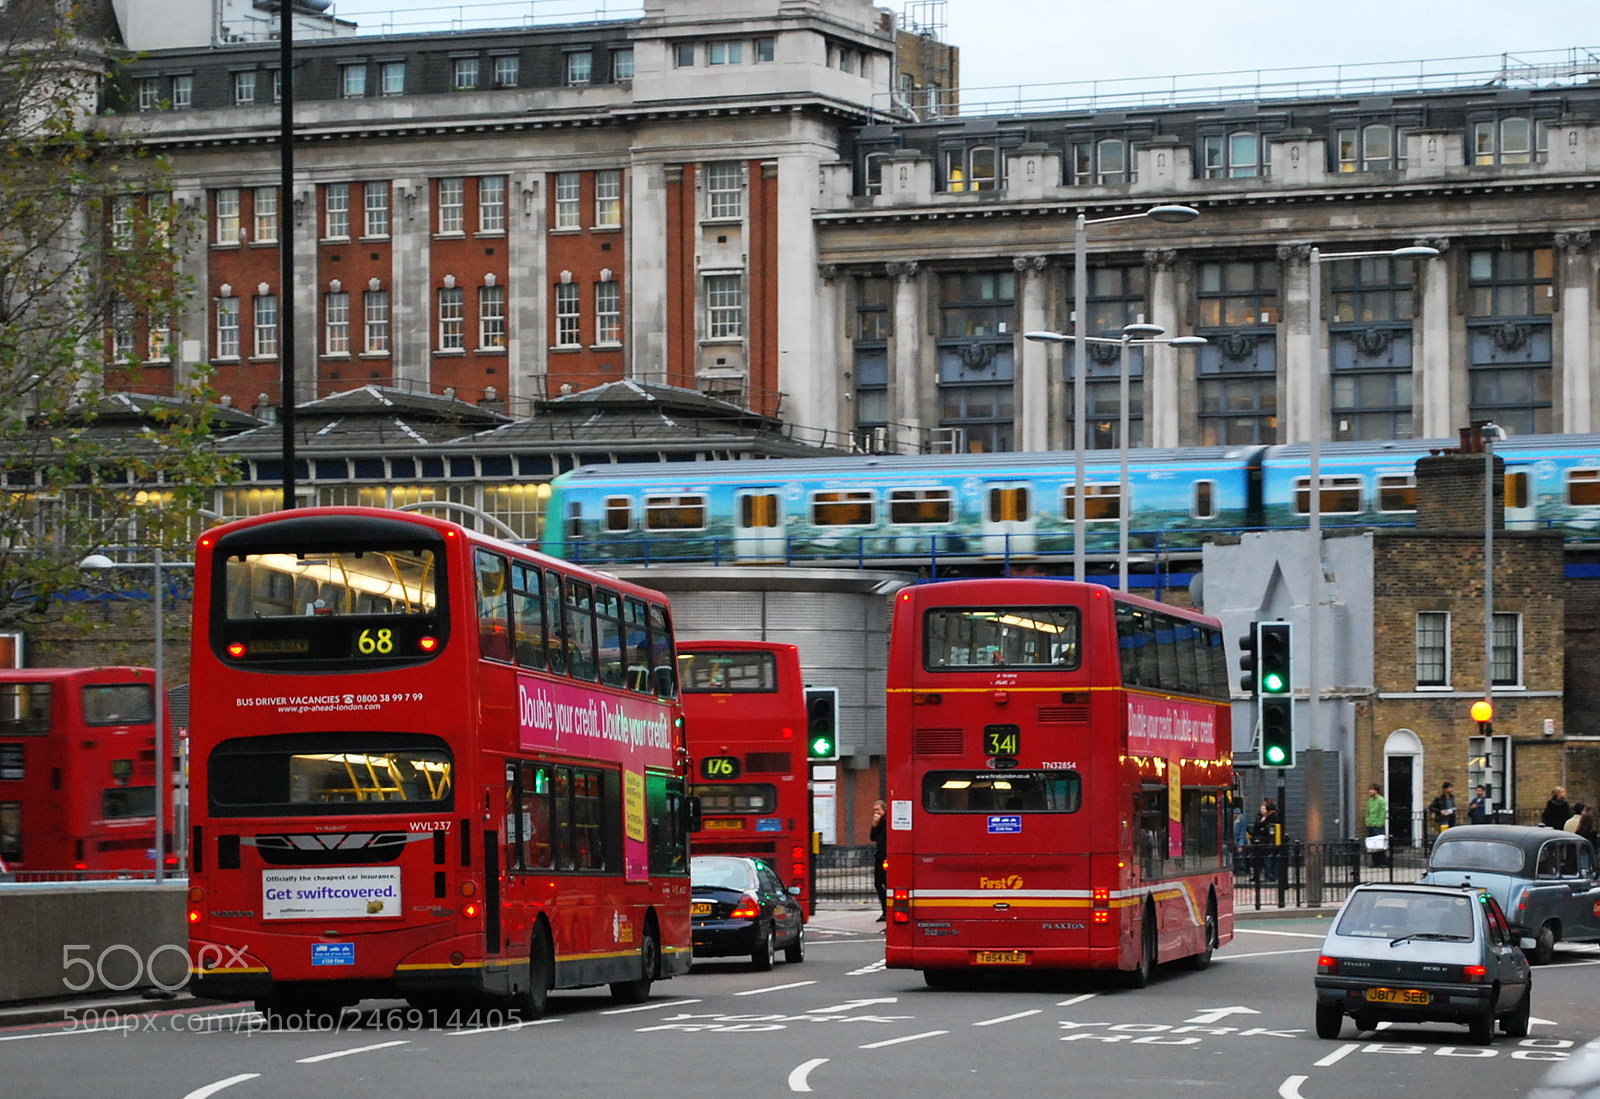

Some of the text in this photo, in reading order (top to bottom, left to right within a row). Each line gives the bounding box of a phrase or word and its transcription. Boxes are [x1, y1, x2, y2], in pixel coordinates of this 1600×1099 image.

[358, 628, 393, 654] 68
[236, 692, 423, 706] BUS DRIVER VACANCIES 0800 38 99 7 99
[278, 703, 381, 713] www.go-ahead-london.com
[519, 684, 671, 753] Double your credit. Double your credit.
[989, 733, 1016, 754] 341
[707, 758, 733, 774] 176
[1041, 761, 1077, 769] TN32854
[409, 821, 451, 831] WVL237
[979, 877, 1006, 889] First
[265, 885, 397, 900] Get swiftcovered.
[1369, 990, 1397, 1001] J817
[1058, 1020, 1307, 1038] YORK
